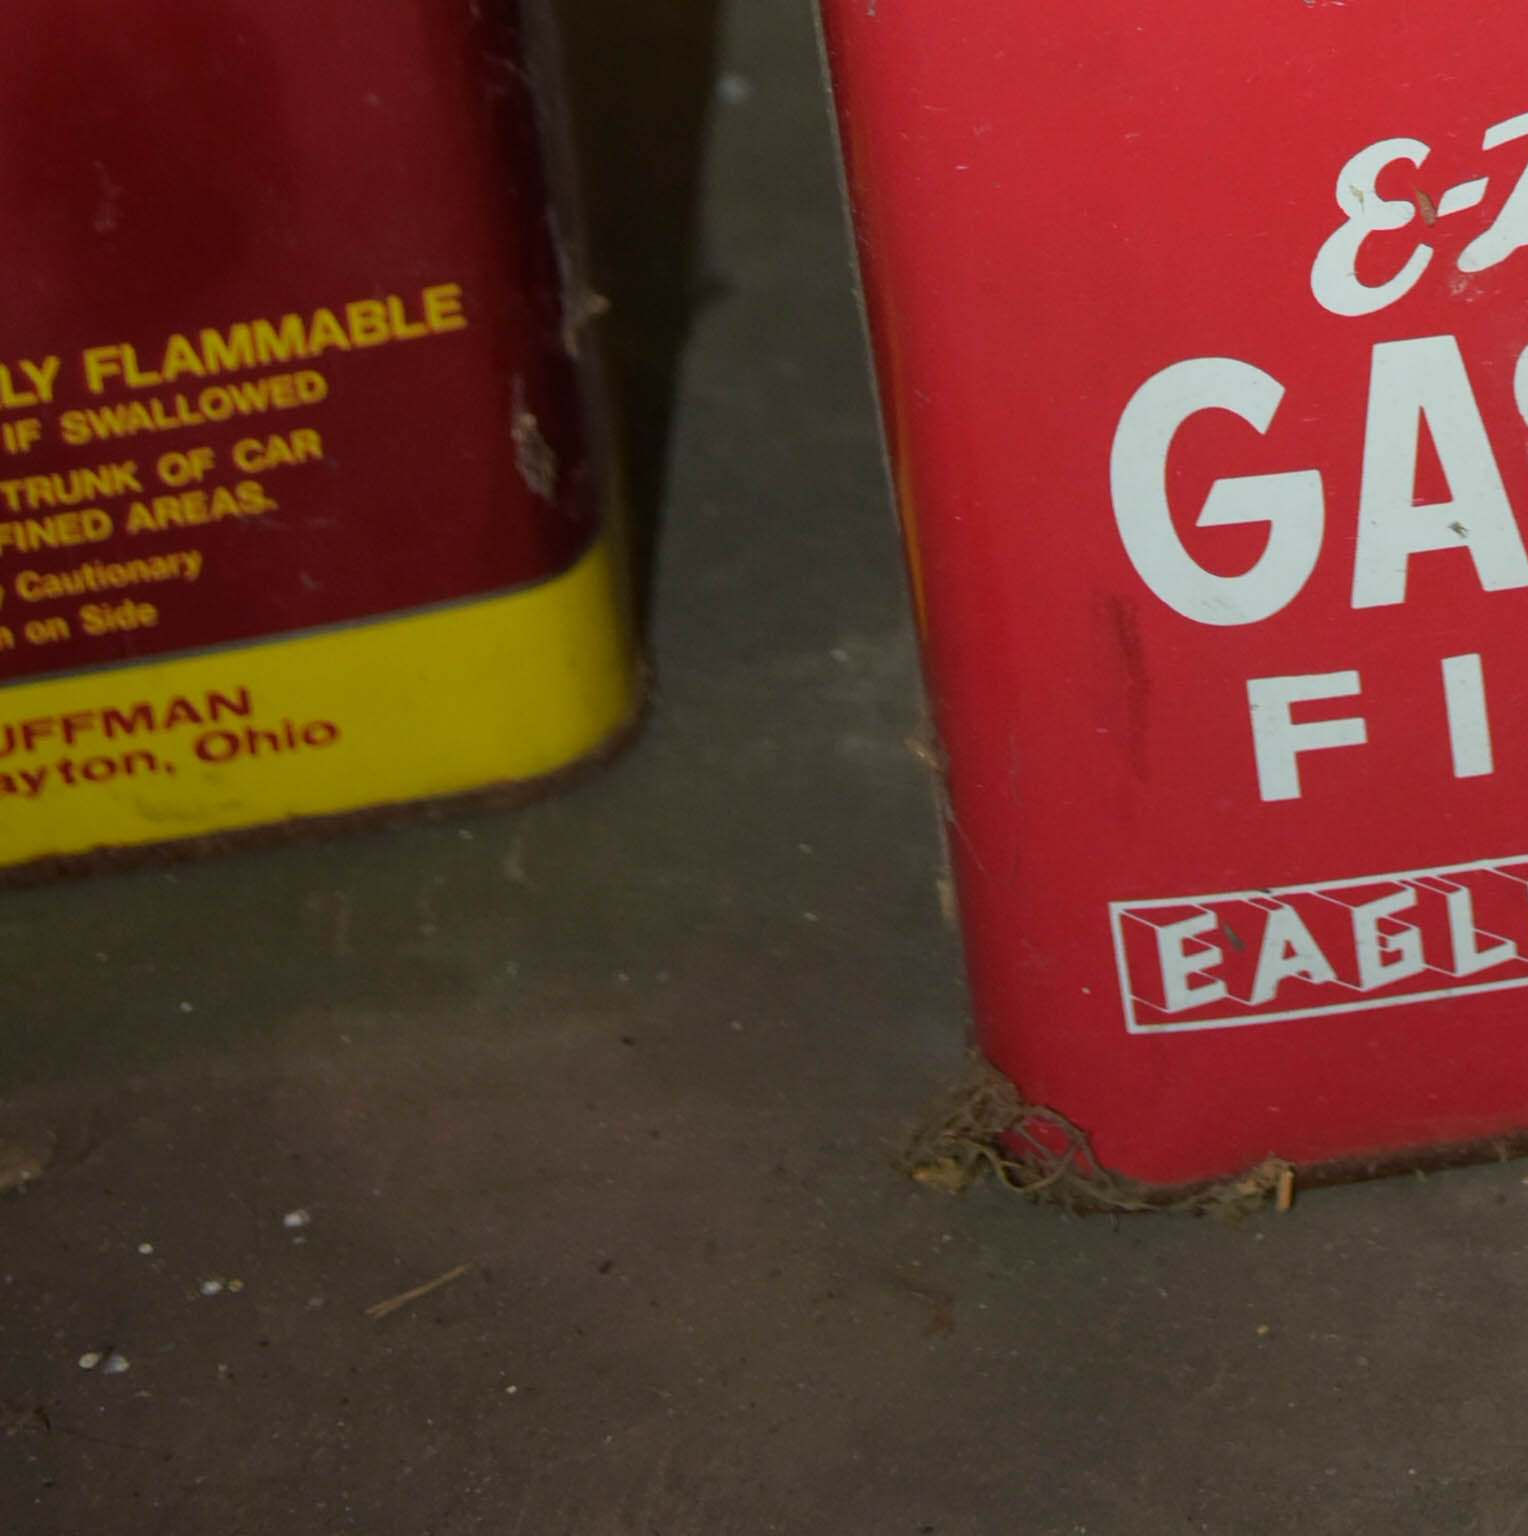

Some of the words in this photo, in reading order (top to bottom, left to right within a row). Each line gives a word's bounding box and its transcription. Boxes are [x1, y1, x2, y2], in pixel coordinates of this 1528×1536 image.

[84, 283, 467, 395] FLAMMABLE
[2, 417, 41, 454] IF
[61, 371, 327, 445] SWALLOWED
[0, 460, 143, 511] TRUNK
[157, 448, 214, 487] OF
[233, 429, 323, 474] CAR
[127, 480, 278, 535] AREAS.
[16, 549, 203, 602] Cautionary
[24, 616, 71, 646] on
[79, 597, 158, 636] Side
[193, 718, 341, 764] Ohio
